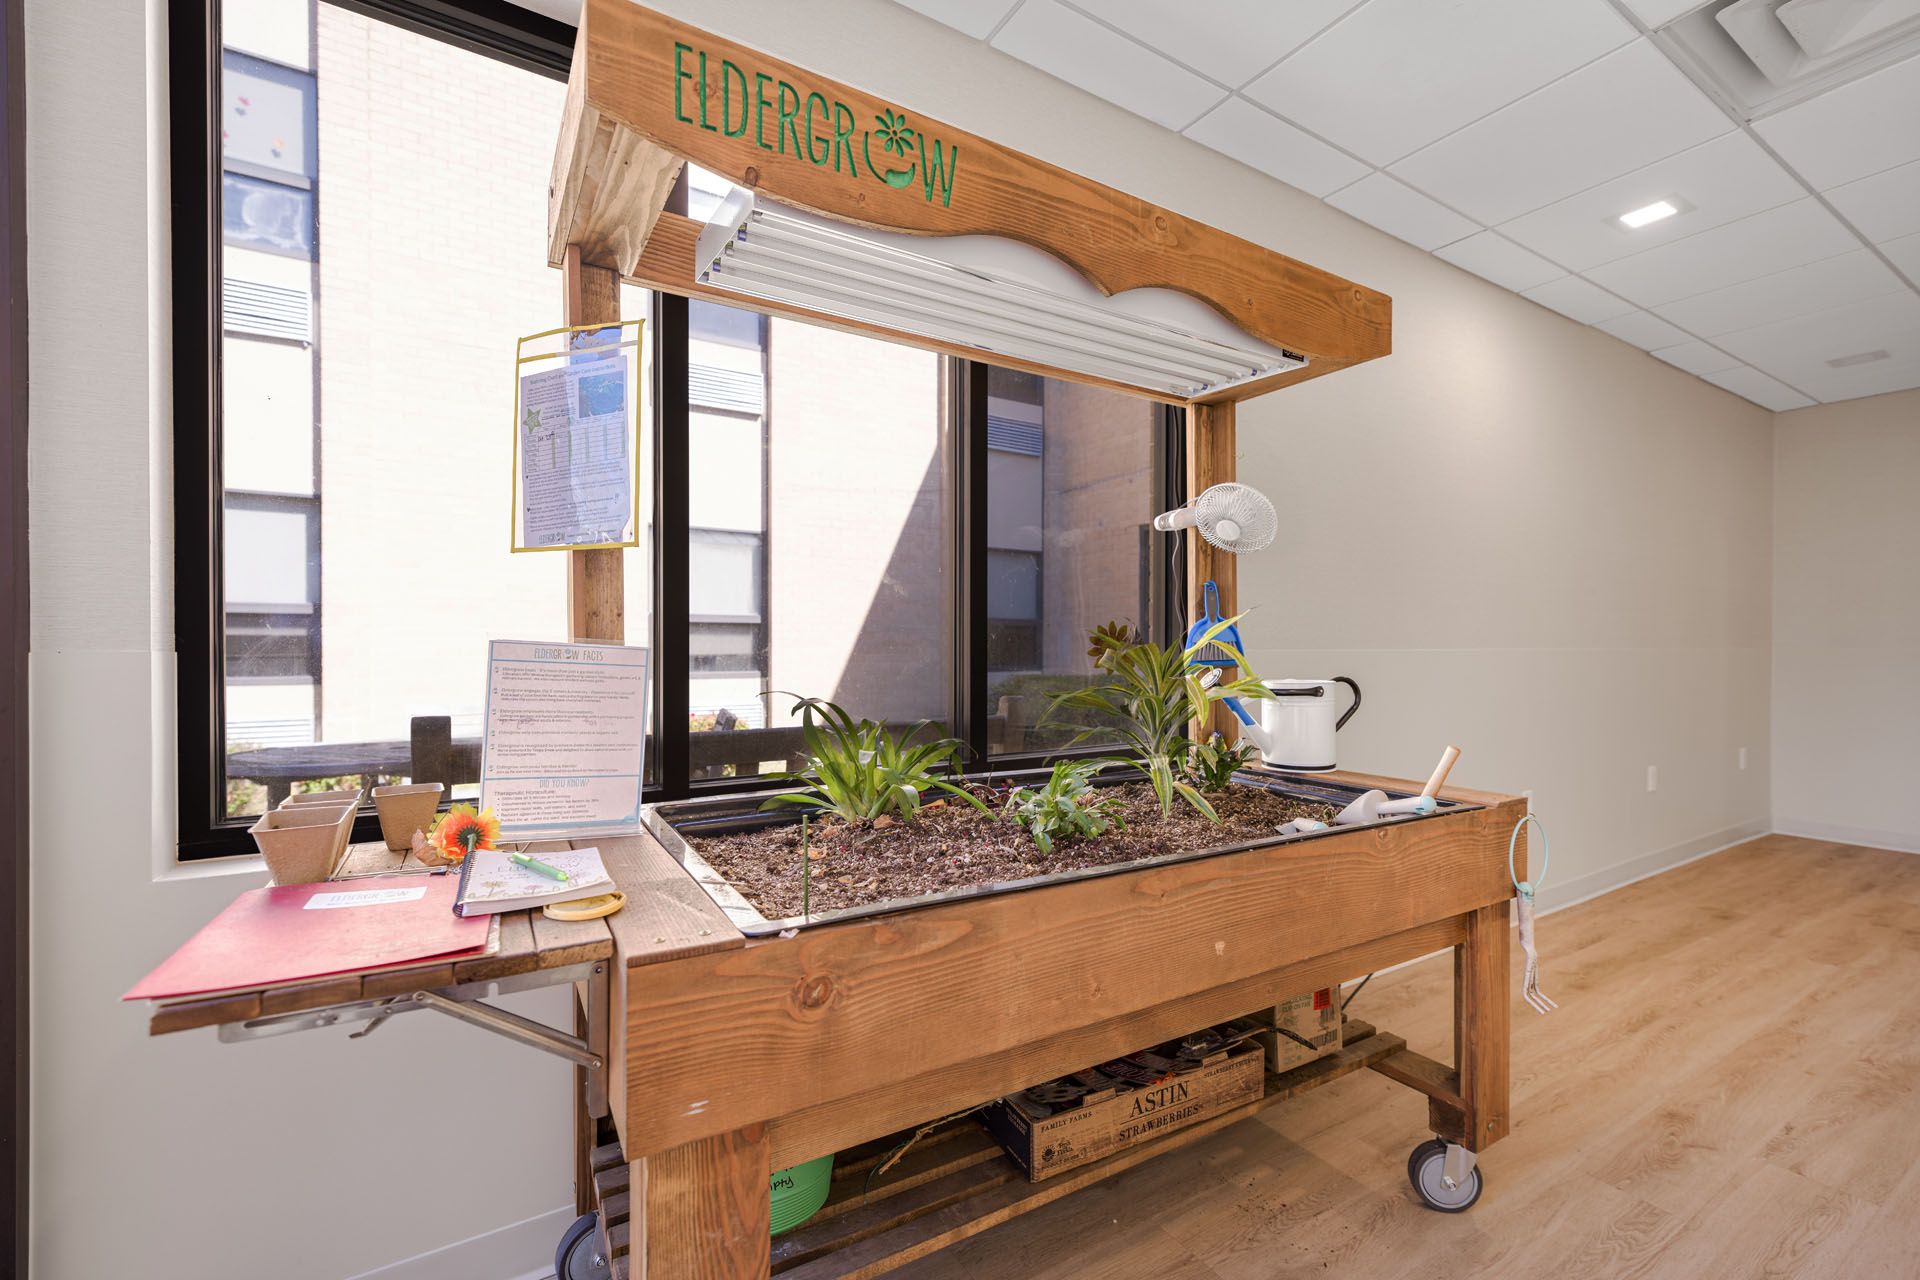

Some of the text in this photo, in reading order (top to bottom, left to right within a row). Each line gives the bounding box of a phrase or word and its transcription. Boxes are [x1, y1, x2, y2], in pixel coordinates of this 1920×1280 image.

[674, 41, 958, 208] ELDERGROW
[534, 648, 604, 661] ELDERGROW FACTS
[539, 778, 590, 788] DID YOU KNOW?
[1130, 1080, 1190, 1118] ASTIN
[1041, 1119, 1068, 1133] FAMILY
[1068, 1111, 1093, 1124] FARMS
[1119, 1103, 1200, 1142] STRAWBERRIES
